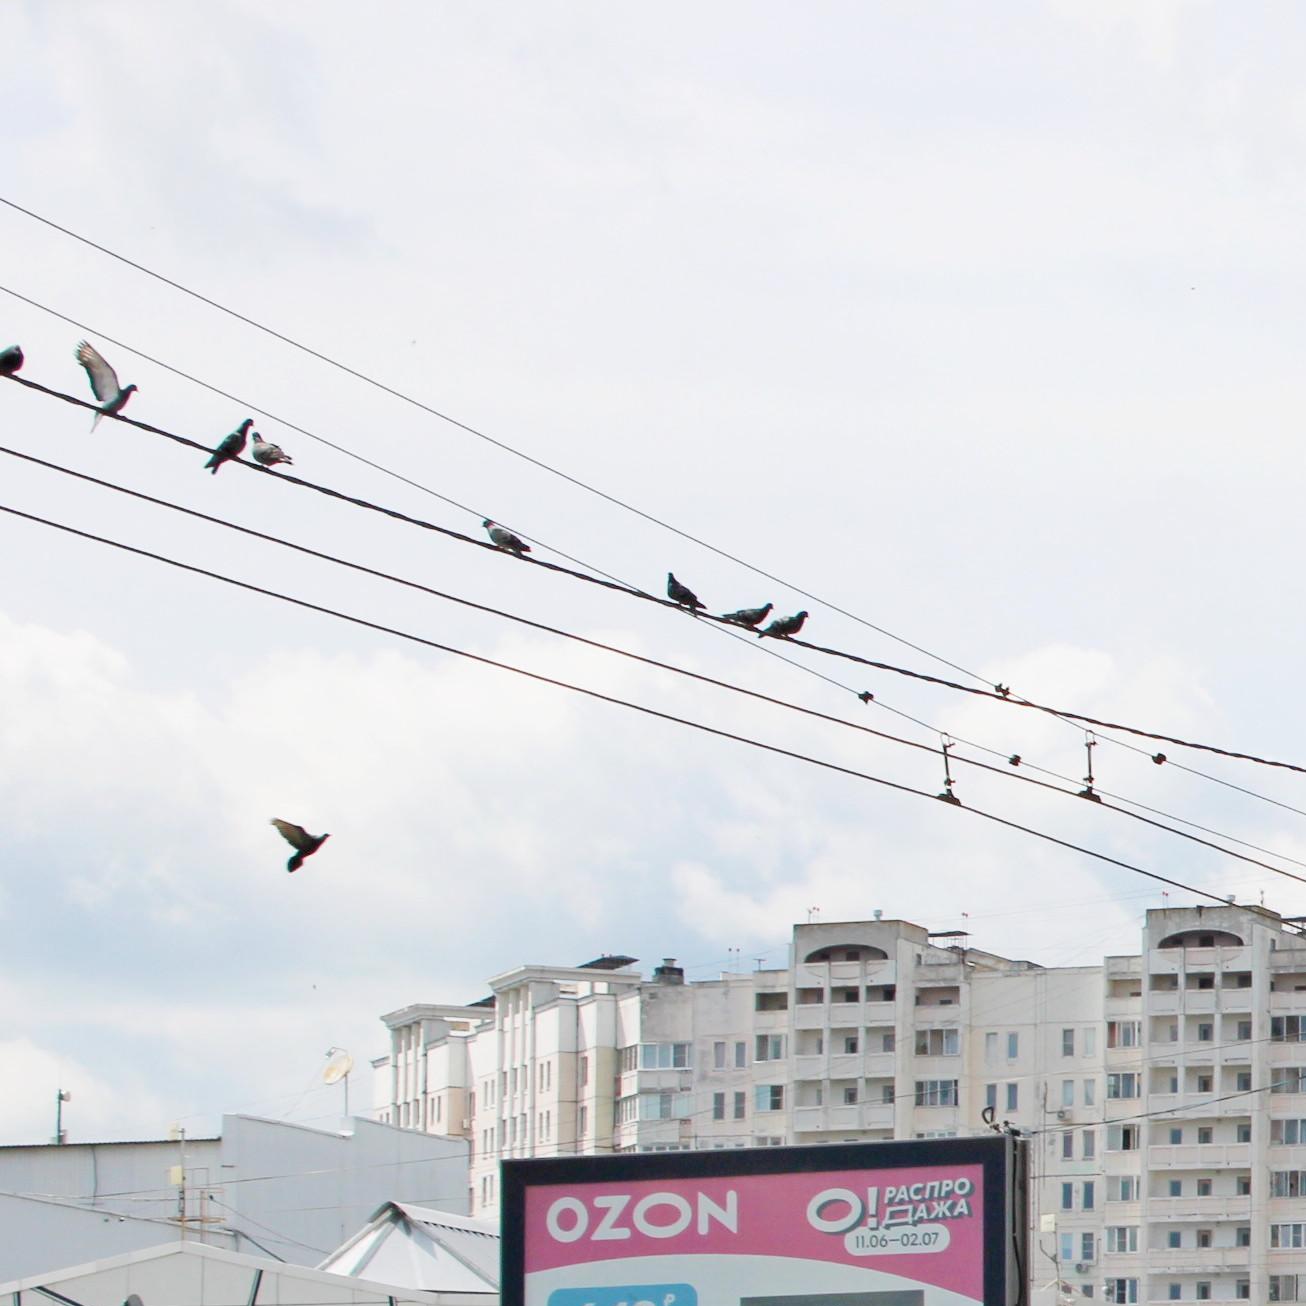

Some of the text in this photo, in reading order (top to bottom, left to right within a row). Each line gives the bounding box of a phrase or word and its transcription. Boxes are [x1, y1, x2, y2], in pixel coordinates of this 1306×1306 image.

[884, 1177, 972, 1203] РАСПРО
[546, 1190, 738, 1244] OZON
[881, 1198, 970, 1228] ДАЖА
